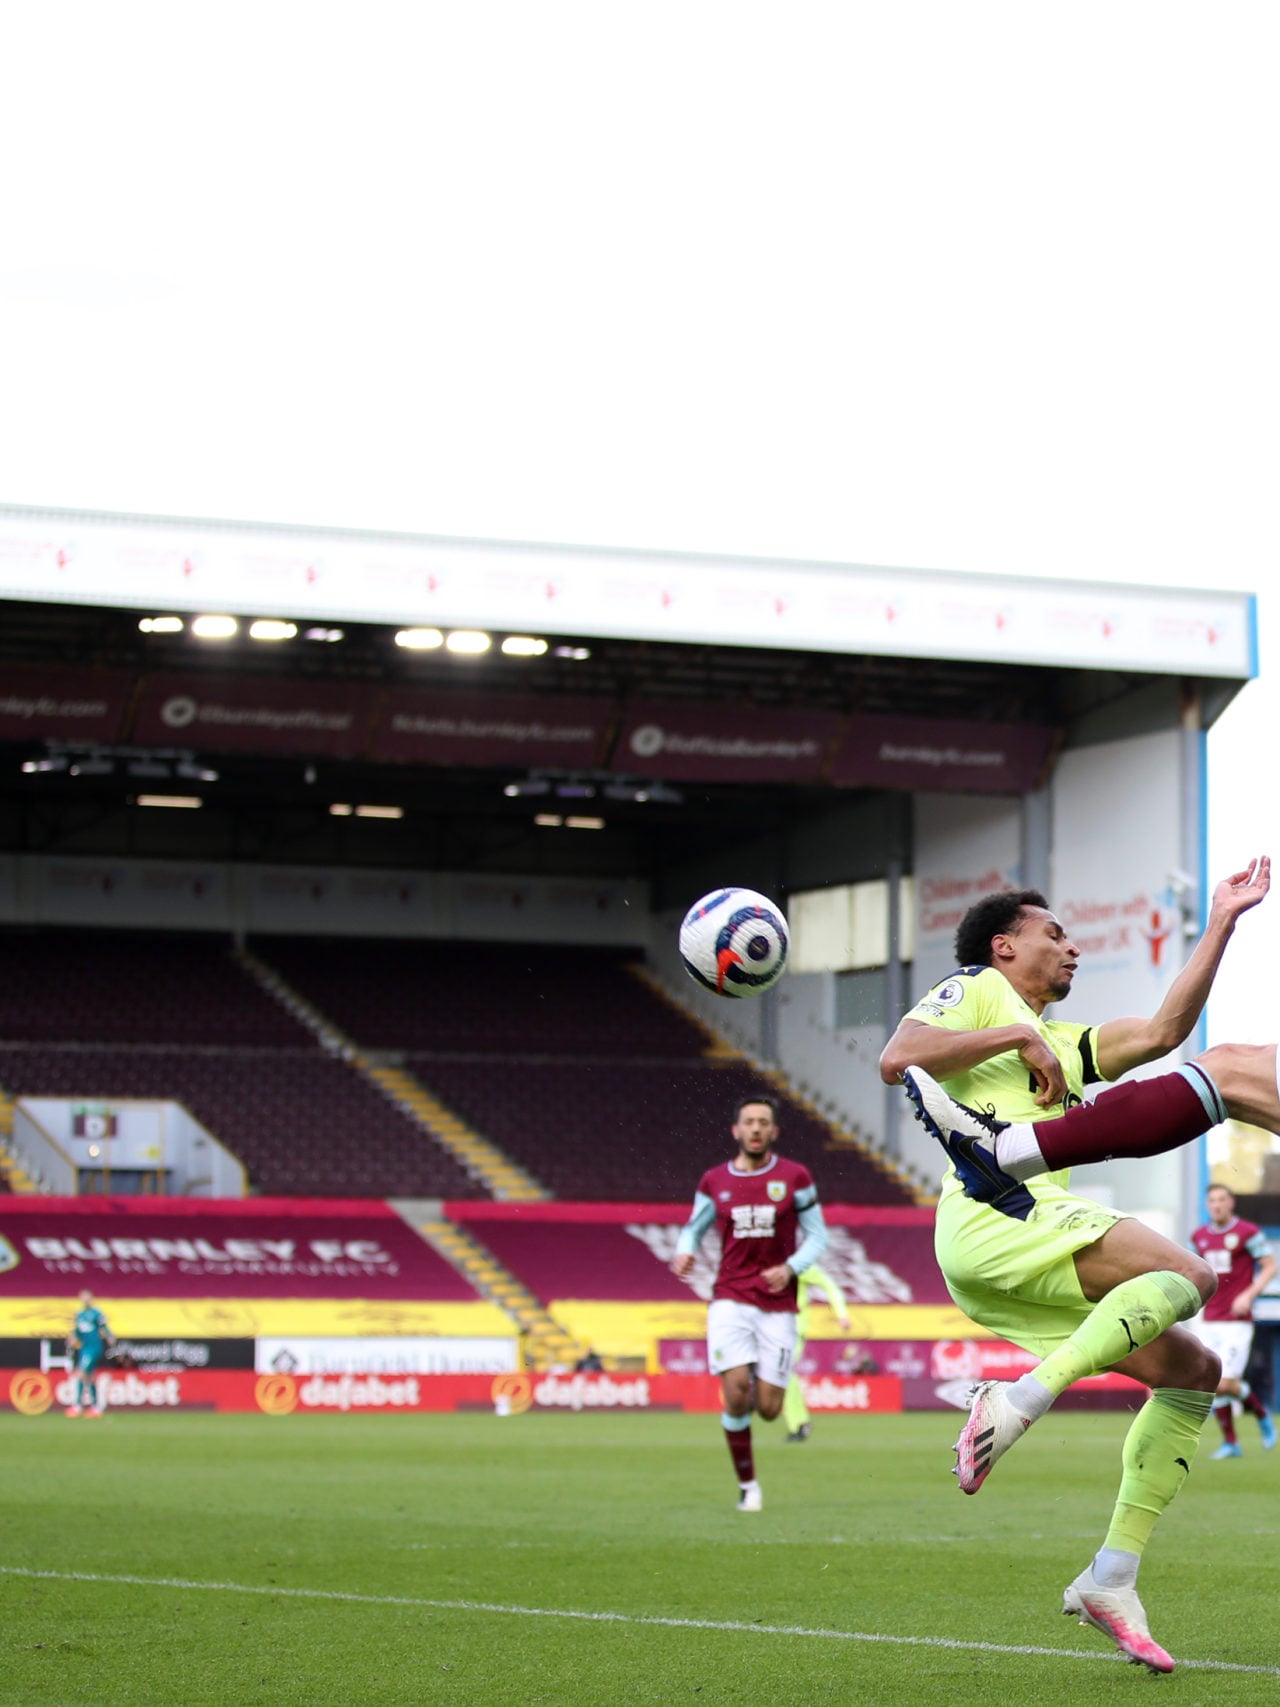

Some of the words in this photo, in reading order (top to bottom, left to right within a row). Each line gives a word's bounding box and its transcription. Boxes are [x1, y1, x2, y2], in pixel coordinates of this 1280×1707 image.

[25, 1238, 294, 1261] BURNLEY
[310, 1238, 391, 1262] FC
[56, 1371, 180, 1412] dfabet
[300, 1373, 420, 1411] dafabet
[533, 1373, 650, 1411] dafabet
[801, 1376, 870, 1409] abet
